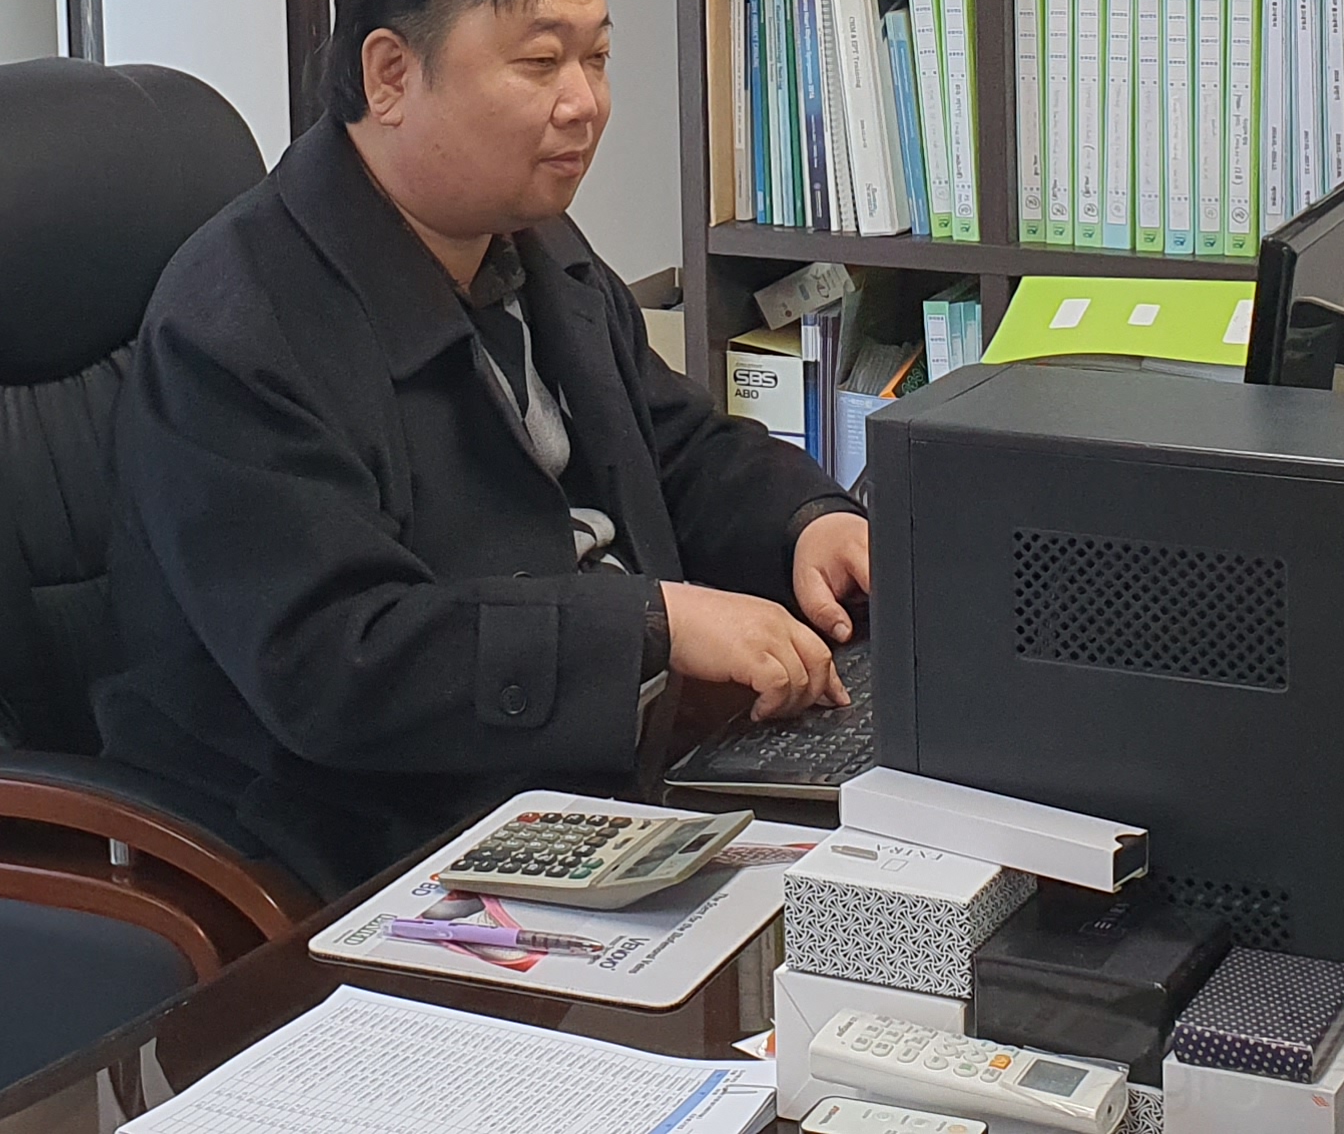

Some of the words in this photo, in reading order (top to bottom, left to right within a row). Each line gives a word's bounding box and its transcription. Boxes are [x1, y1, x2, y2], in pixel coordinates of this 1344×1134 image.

[852, 56, 863, 89] Training
[735, 369, 776, 387] SBS
[735, 388, 759, 400] ABO
